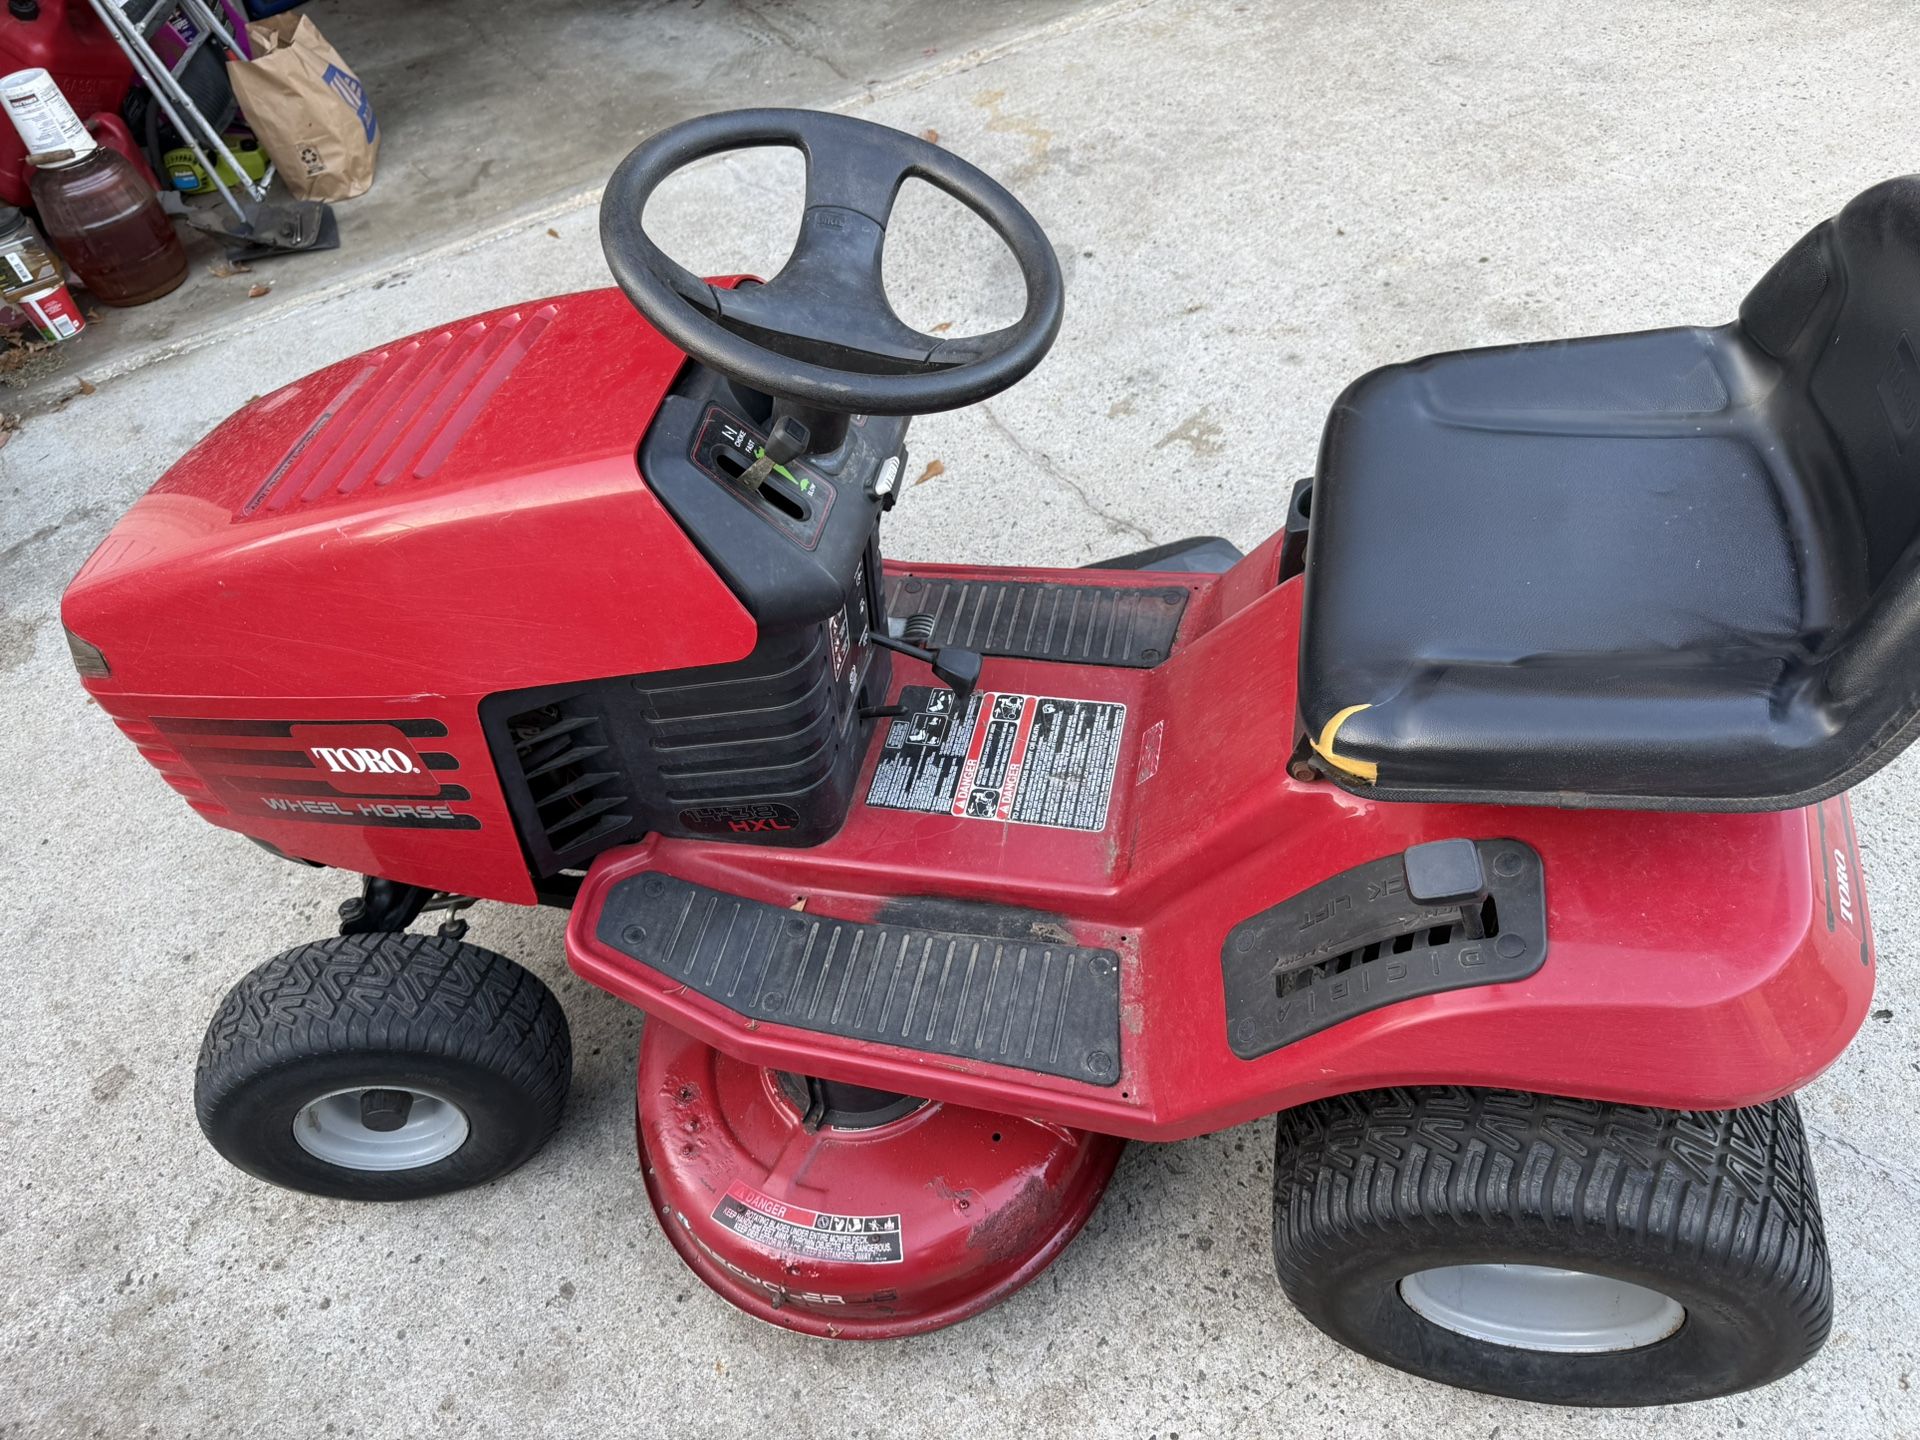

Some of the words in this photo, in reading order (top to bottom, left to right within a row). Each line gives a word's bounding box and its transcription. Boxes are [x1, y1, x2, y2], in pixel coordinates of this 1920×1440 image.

[734, 430, 747, 448] CHOKE
[745, 439, 755, 453] FAST
[957, 758, 977, 798] DANGER
[1001, 763, 1020, 802] DANGER
[260, 797, 352, 816] WHEEL
[357, 803, 455, 820] HORSE
[728, 818, 792, 833] HXL
[1367, 874, 1407, 902] CK
[1834, 848, 1854, 925] TORO
[1299, 894, 1352, 933] LIFT
[745, 1192, 787, 1218] DANGER
[723, 1207, 737, 1219] KEEP
[736, 1214, 753, 1228] HANDS
[761, 1226, 776, 1237] FEET
[792, 1235, 815, 1246] THROWN
[815, 1240, 841, 1252] OBJECTS
[841, 1243, 854, 1252] ARE
[854, 1243, 892, 1253] DANGEROUS.
[733, 1223, 747, 1235] KEEP
[746, 1230, 776, 1247] DEFLECTOR
[802, 1246, 818, 1256] KEEP
[819, 1249, 855, 1260] BYSTANDERS
[745, 1209, 769, 1226] ROTATING
[768, 1220, 790, 1235] BLADES
[790, 1226, 809, 1238] UNDER
[809, 1230, 830, 1241] ENTIRE
[829, 1234, 851, 1243] MOWER
